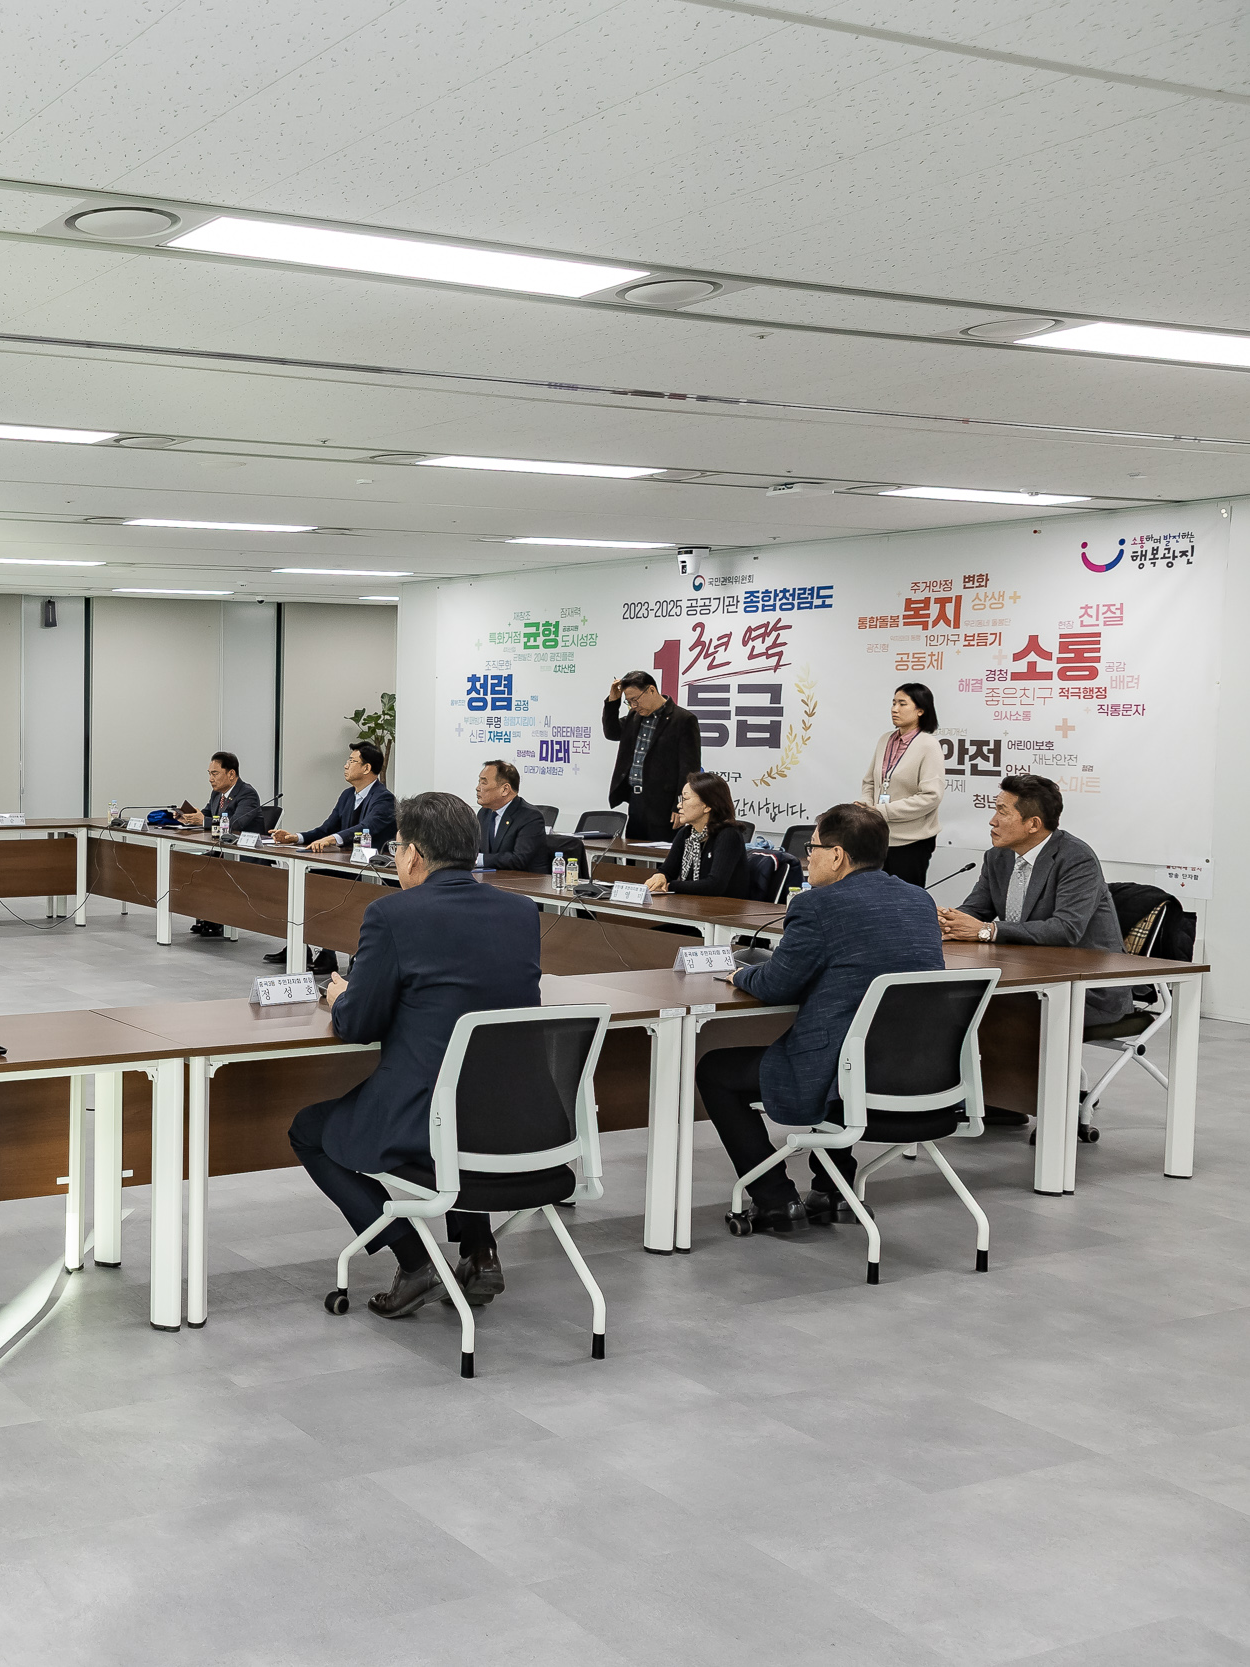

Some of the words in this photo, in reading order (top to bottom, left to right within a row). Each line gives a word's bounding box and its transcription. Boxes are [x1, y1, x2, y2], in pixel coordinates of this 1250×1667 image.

[1131, 534, 1161, 549] 소통하며
[1163, 531, 1195, 547] 발전하는
[1130, 545, 1195, 570] 행복광진
[708, 574, 754, 586] 국민권익위원회
[910, 579, 953, 594] 주거안정
[962, 573, 990, 589] 변화
[622, 599, 683, 620] 2023-2025
[686, 595, 740, 617] 공공기관
[743, 585, 834, 614] 종합청렴도
[971, 590, 1006, 611] 상생
[902, 594, 963, 631] 복지
[1079, 602, 1124, 628] 친절
[857, 615, 900, 630] 통합돌봄
[1058, 621, 1074, 630] 현장
[488, 631, 522, 645] 특화거점
[523, 620, 560, 650] 균형
[561, 633, 598, 648] 도시성장
[924, 634, 961, 647] 1인가구
[962, 632, 1002, 648] 보듬기
[682, 622, 732, 675] 3년
[742, 618, 793, 673] 연속
[894, 651, 944, 672] 공동체
[1010, 631, 1102, 682] 소통
[1105, 661, 1126, 673] 공감
[985, 669, 1009, 682] 경청
[1110, 674, 1141, 690] 배려
[466, 674, 513, 711] 청렴
[958, 678, 983, 693] 해결
[1058, 686, 1108, 700] 적극행정
[984, 686, 1054, 707] 좋은친구
[514, 699, 529, 711] 공정
[1097, 703, 1146, 717] 직통문자
[486, 716, 502, 728] 투명
[993, 710, 1032, 722] 의사소통
[469, 729, 487, 744] 신뢰
[487, 730, 512, 743] 자부심
[551, 726, 592, 739] GREEN힐링
[538, 740, 571, 764] 미래
[572, 740, 591, 754] 도전
[1007, 740, 1055, 751] 어린이보호
[938, 738, 1002, 777] 안전
[1032, 753, 1078, 767] 재난안전
